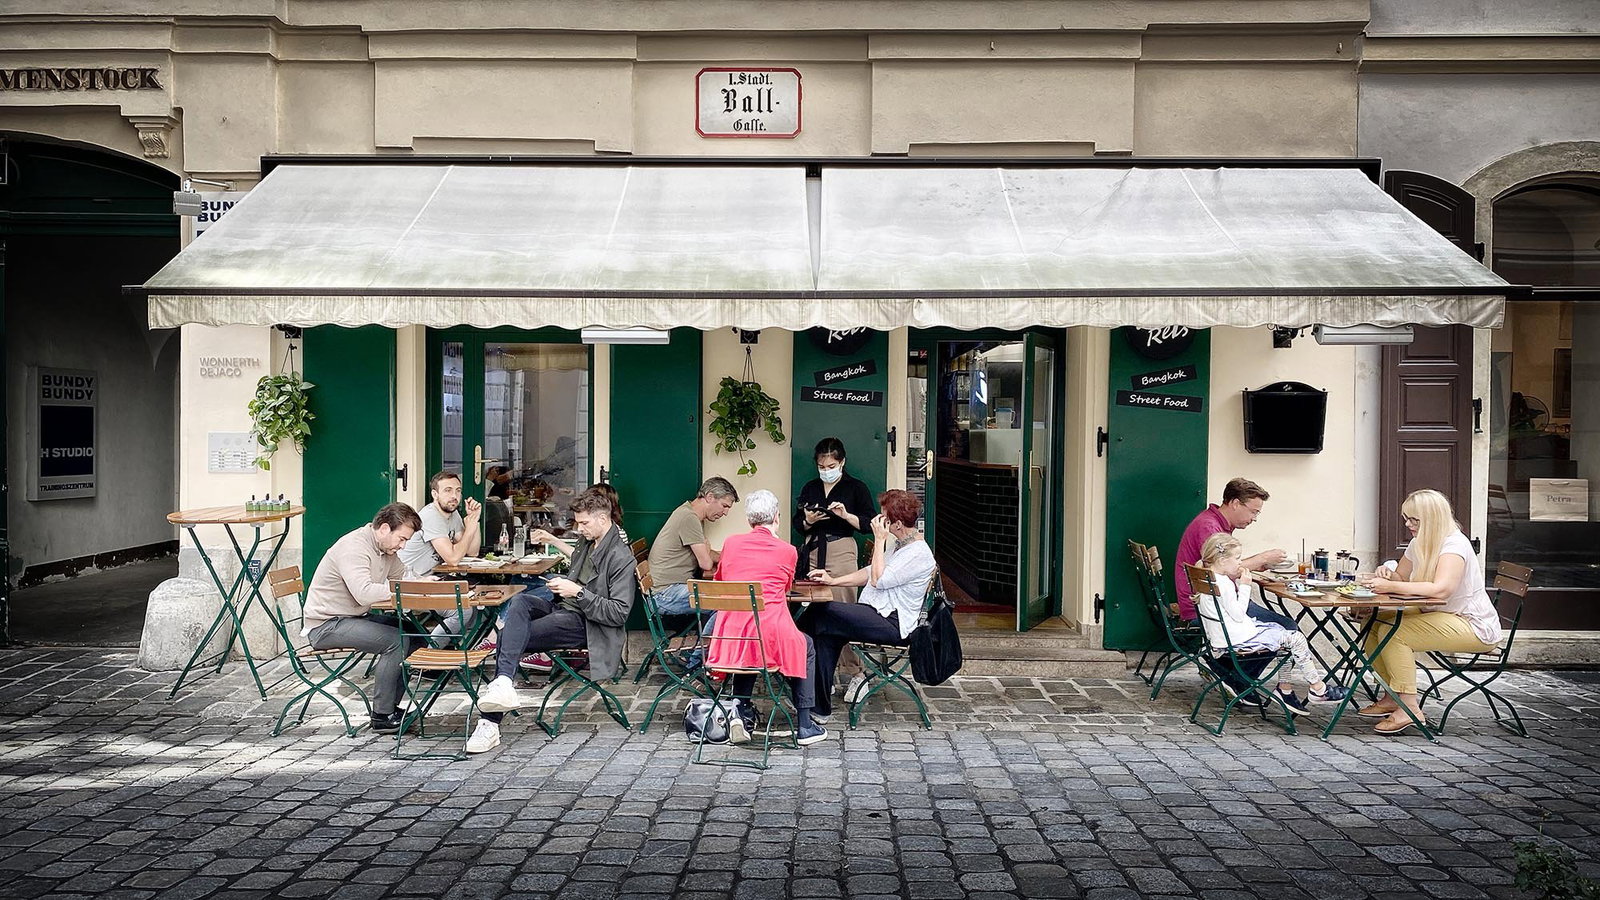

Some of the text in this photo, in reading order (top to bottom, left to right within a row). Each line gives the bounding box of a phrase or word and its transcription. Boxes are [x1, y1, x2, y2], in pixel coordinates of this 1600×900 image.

[201, 201, 239, 211] BUN
[199, 357, 261, 367] WONNERTH
[200, 367, 242, 377] DEJACO
[824, 365, 867, 381] Bangkok
[1141, 370, 1187, 385] Bangkok
[42, 374, 94, 388] BUNDY
[42, 387, 94, 400] BUNDY
[813, 390, 870, 402] Street Food
[1129, 394, 1189, 408] Street Food
[52, 447, 94, 458] STUDIO
